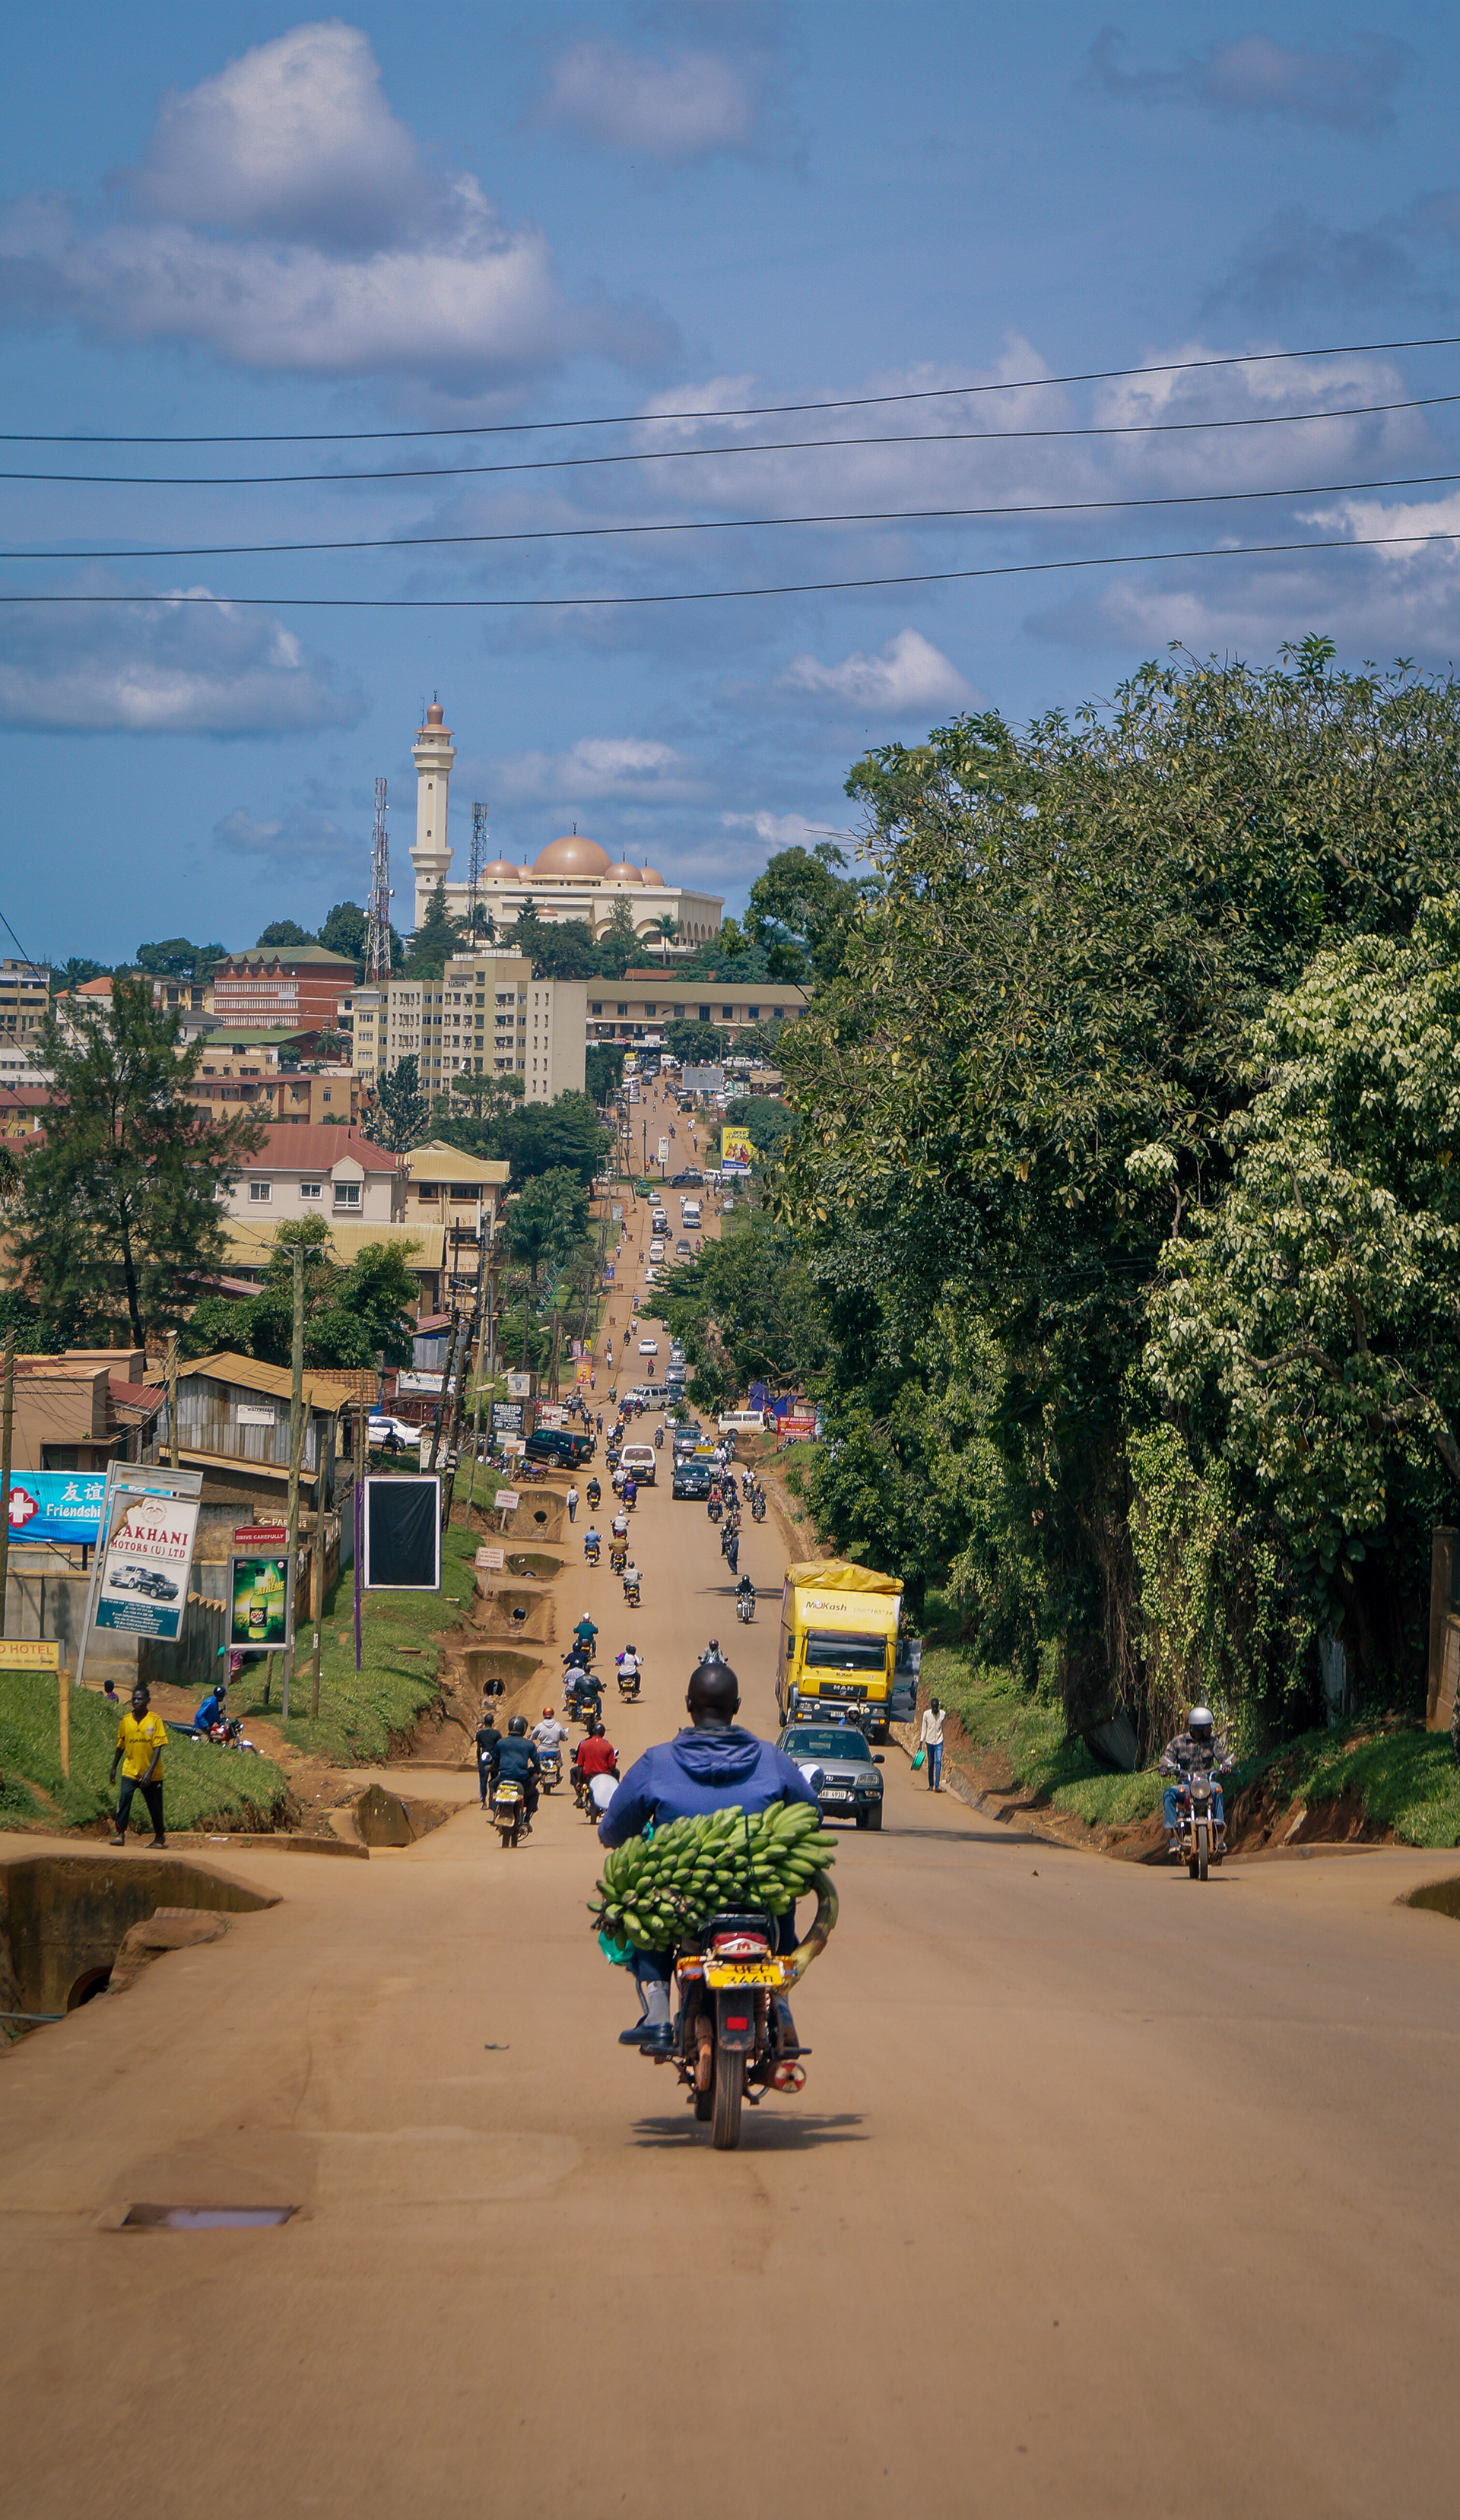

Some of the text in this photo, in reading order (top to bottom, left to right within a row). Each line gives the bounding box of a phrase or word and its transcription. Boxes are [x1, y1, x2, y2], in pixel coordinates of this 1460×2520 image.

[46, 1503, 108, 1518] Friendshi
[111, 1539, 186, 1558] MOTORS (U) LTD
[10, 1644, 54, 1655] HOTEL
